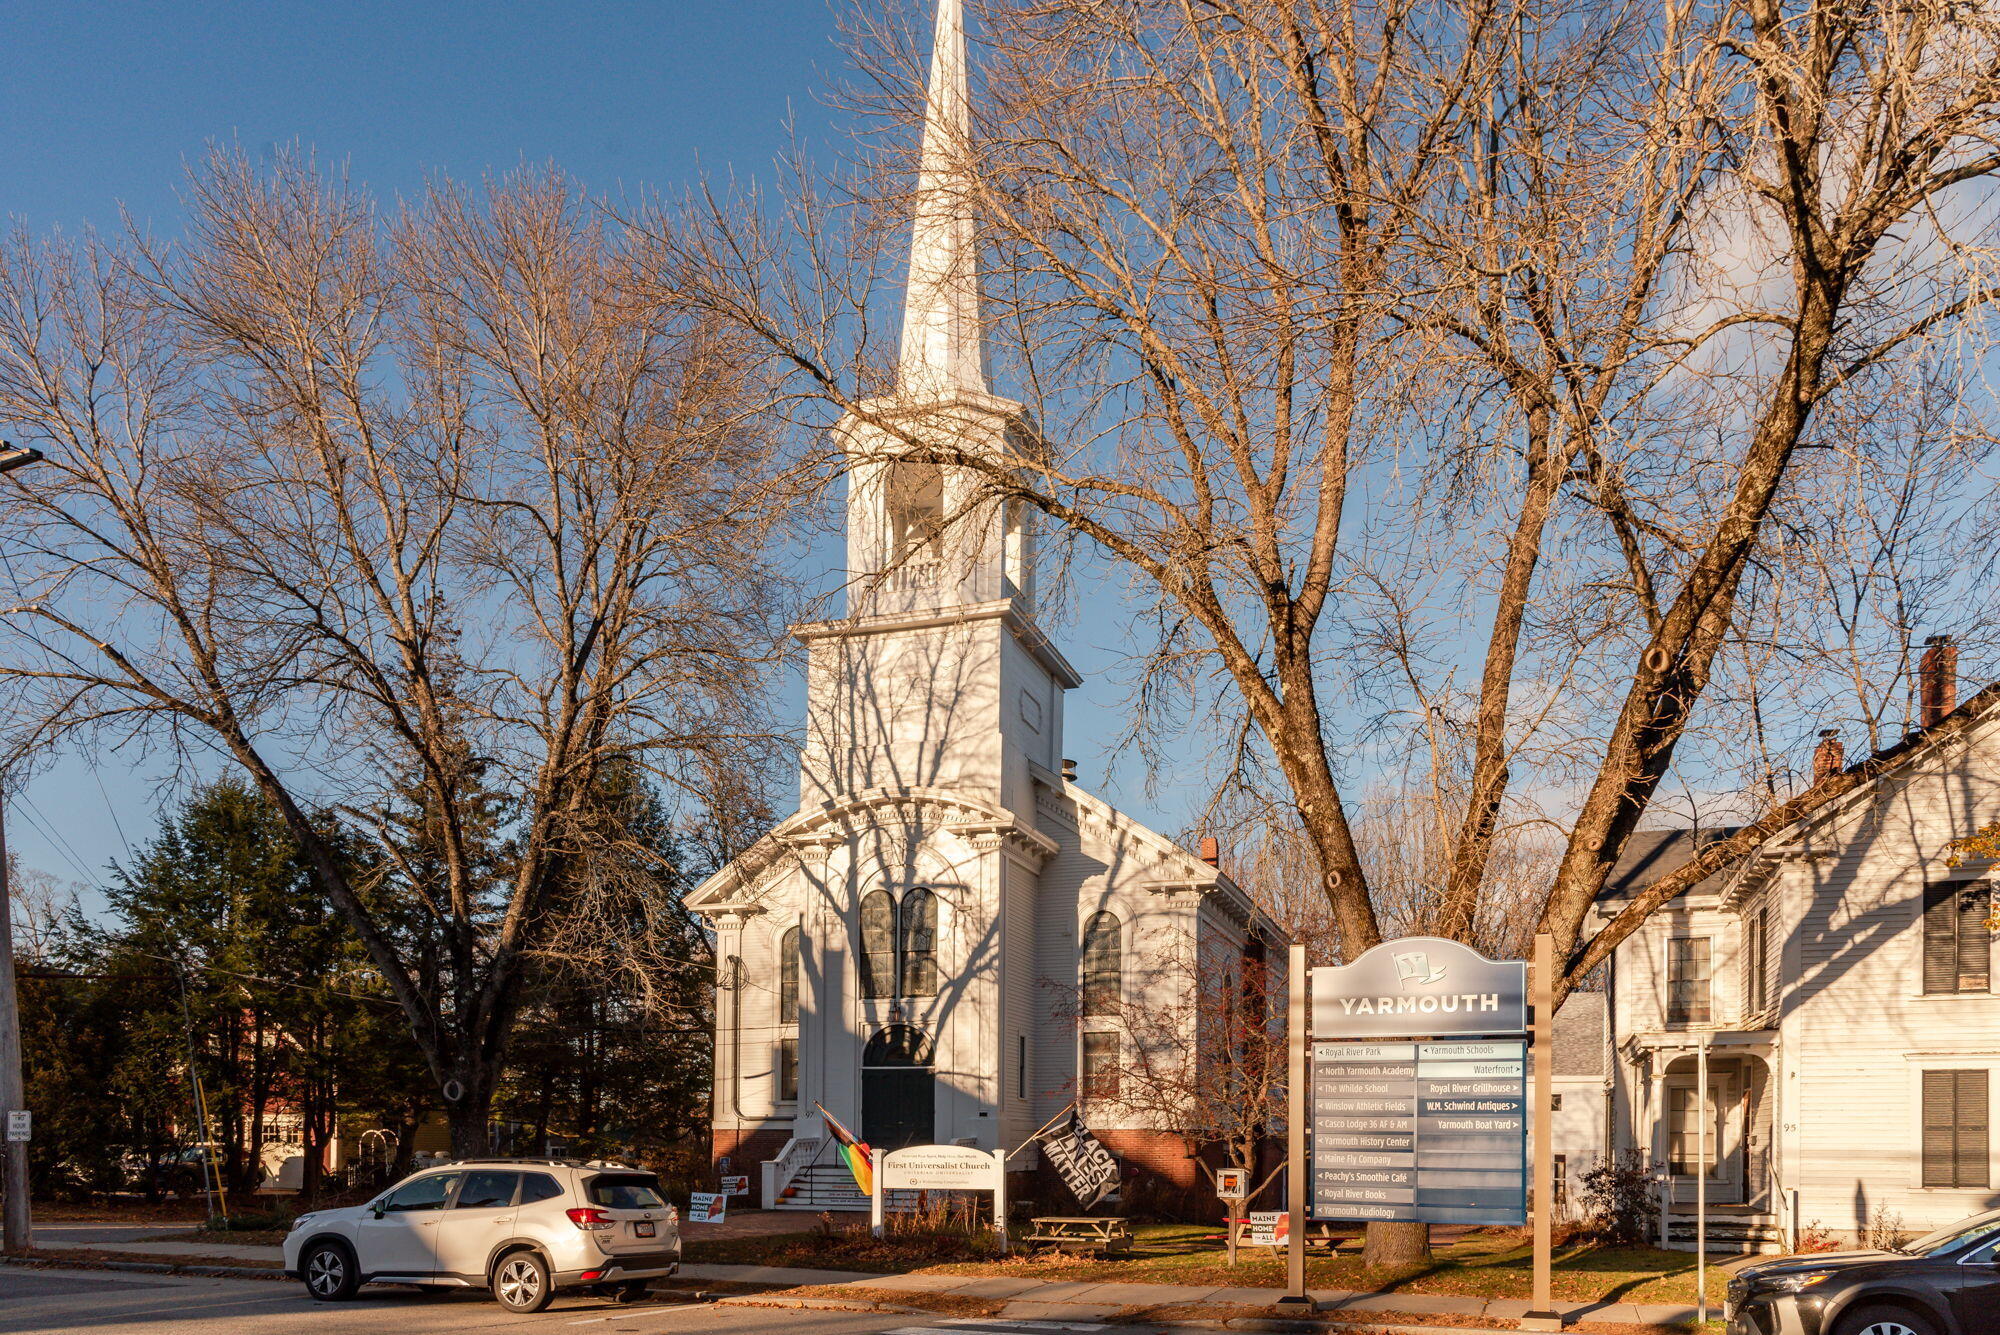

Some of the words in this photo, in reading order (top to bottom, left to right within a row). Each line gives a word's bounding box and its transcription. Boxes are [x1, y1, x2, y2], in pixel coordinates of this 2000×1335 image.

[1339, 993, 1499, 1015] YARMOUTH
[1325, 1049, 1344, 1058] Royal
[1346, 1048, 1363, 1056] River
[1366, 1048, 1381, 1056] Park
[1430, 1046, 1464, 1054] Yarmouth
[1466, 1045, 1494, 1054] Schools
[1325, 1067, 1345, 1076] North
[1346, 1067, 1380, 1075] Yarmouth
[1382, 1066, 1415, 1077] Academy
[1474, 1065, 1513, 1074] Waterfront
[1325, 1084, 1336, 1093] The
[1340, 1084, 1364, 1093] Whilde
[1364, 1084, 1388, 1093] School
[1430, 1084, 1450, 1094] Royal
[1452, 1083, 1470, 1093] River
[1472, 1083, 1511, 1093] Grillhouse
[1325, 1102, 1354, 1110] Winslow
[1356, 1102, 1383, 1111] Athletic
[1385, 1102, 1406, 1111] Fields
[1426, 1102, 1442, 1111] W.M.
[1444, 1101, 1475, 1111] Schwind
[1477, 1101, 1510, 1112] Antiques
[1324, 1120, 1344, 1128] Casco
[1347, 1120, 1367, 1130] Lodge
[1370, 1120, 1378, 1128] 36
[1380, 1120, 1388, 1128] AF
[1390, 1120, 1395, 1128] &
[1396, 1120, 1408, 1128] AM
[1438, 1120, 1473, 1129] Yarmouth
[1475, 1120, 1492, 1129] Boat
[1494, 1120, 1511, 1129] Yard
[1784, 1123, 1796, 1132] 95
[1324, 1137, 1358, 1145] Yarmouth
[1360, 1137, 1384, 1147] History
[1386, 1137, 1410, 1146] Center
[1074, 1119, 1117, 1177] BLACK
[1061, 1134, 1104, 1187] LIVES
[1324, 1154, 1345, 1162] Maine
[1347, 1154, 1356, 1165] Fly
[1359, 1155, 1391, 1165] Company
[908, 1161, 957, 1169] Universalist
[1043, 1141, 1092, 1200] MATTER
[1324, 1172, 1354, 1183] Peachy's
[1356, 1172, 1390, 1182] Smoothie
[1391, 1172, 1407, 1182] Café
[1324, 1189, 1344, 1199] Royal
[1345, 1189, 1363, 1198] River
[1365, 1190, 1386, 1199] Books
[1324, 1207, 1357, 1216] Yarmouth
[1360, 1207, 1395, 1219] Audiology
